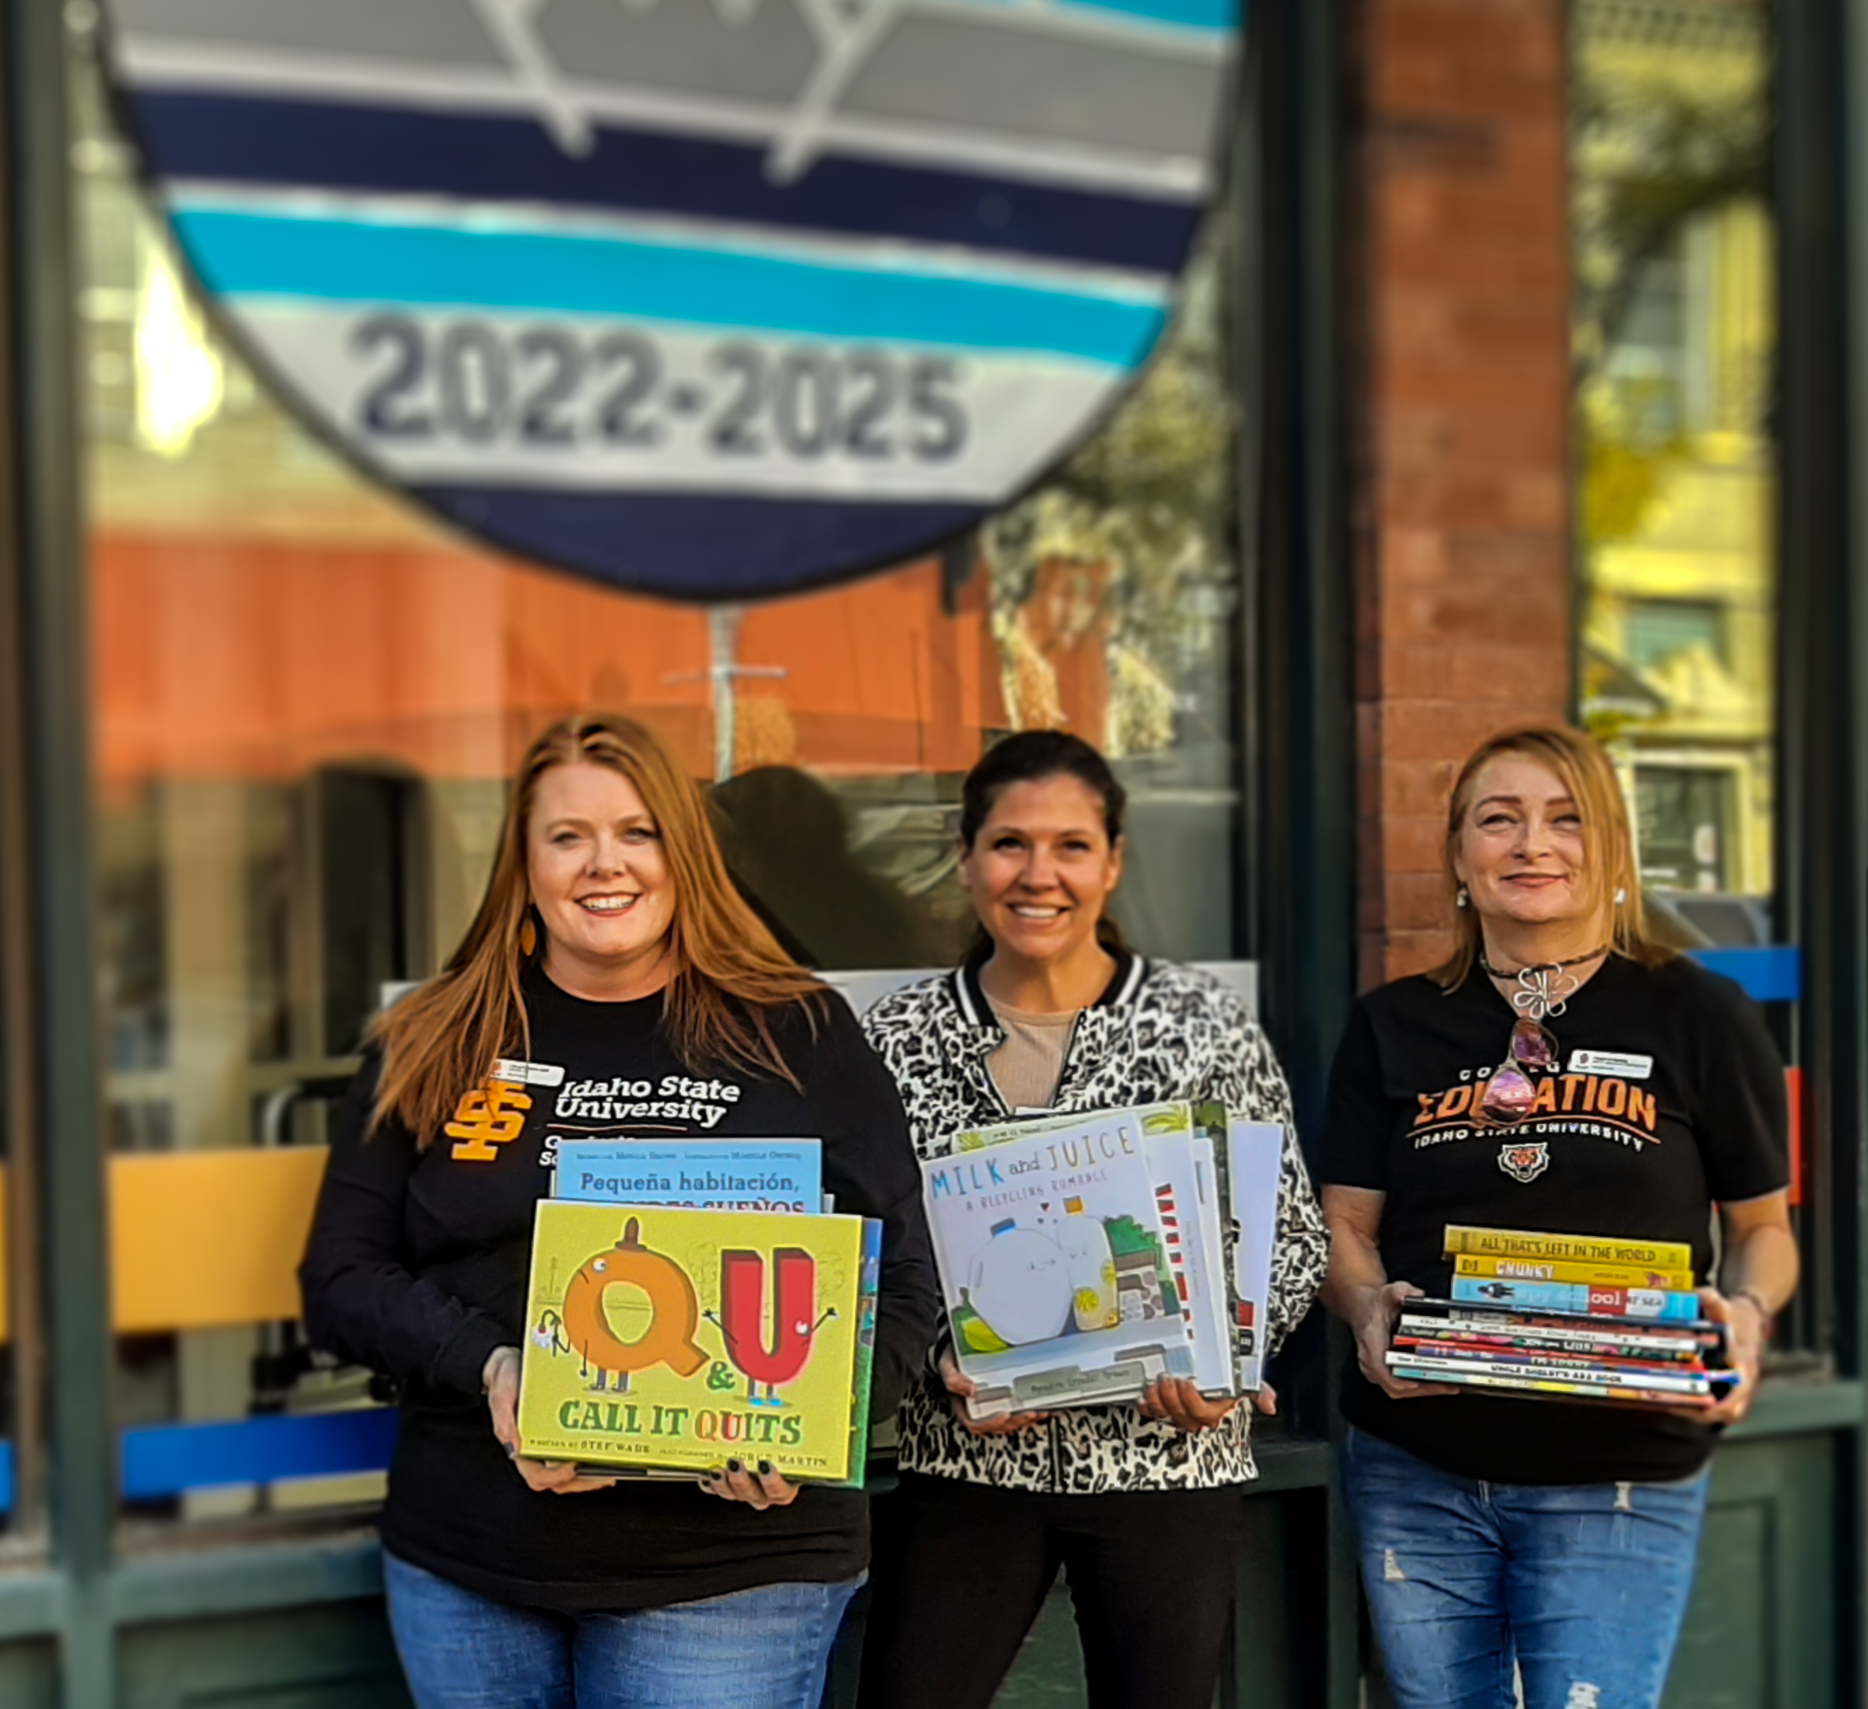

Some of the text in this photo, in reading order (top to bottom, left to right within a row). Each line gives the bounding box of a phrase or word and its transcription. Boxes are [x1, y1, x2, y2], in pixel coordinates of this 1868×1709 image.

[350, 308, 970, 464] 2022-2025
[558, 1075, 741, 1102] Idaho State
[554, 1097, 727, 1129] University
[1414, 1128, 1469, 1149] IDAHO
[1536, 1122, 1644, 1152] UNIVERSITY
[930, 1156, 1005, 1199] MILK
[1009, 1151, 1041, 1175] and
[1046, 1126, 1134, 1172] JUICE
[581, 1170, 800, 1195] Pequeña habitación,
[965, 1168, 1108, 1212] A RECYCLING ROMANCE
[1480, 1236, 1499, 1250] ALL
[1503, 1238, 1543, 1253] THAT'S
[1545, 1241, 1571, 1257] LEFT
[1573, 1244, 1587, 1257] IN
[1590, 1245, 1611, 1259] THE
[1614, 1247, 1656, 1262] WORLD
[1495, 1260, 1555, 1279] CHUNKY
[563, 1247, 814, 1390] Q & U
[558, 1400, 801, 1445] CALL IT QUITS
[581, 1440, 614, 1451] STEF
[617, 1442, 650, 1453] WADE
